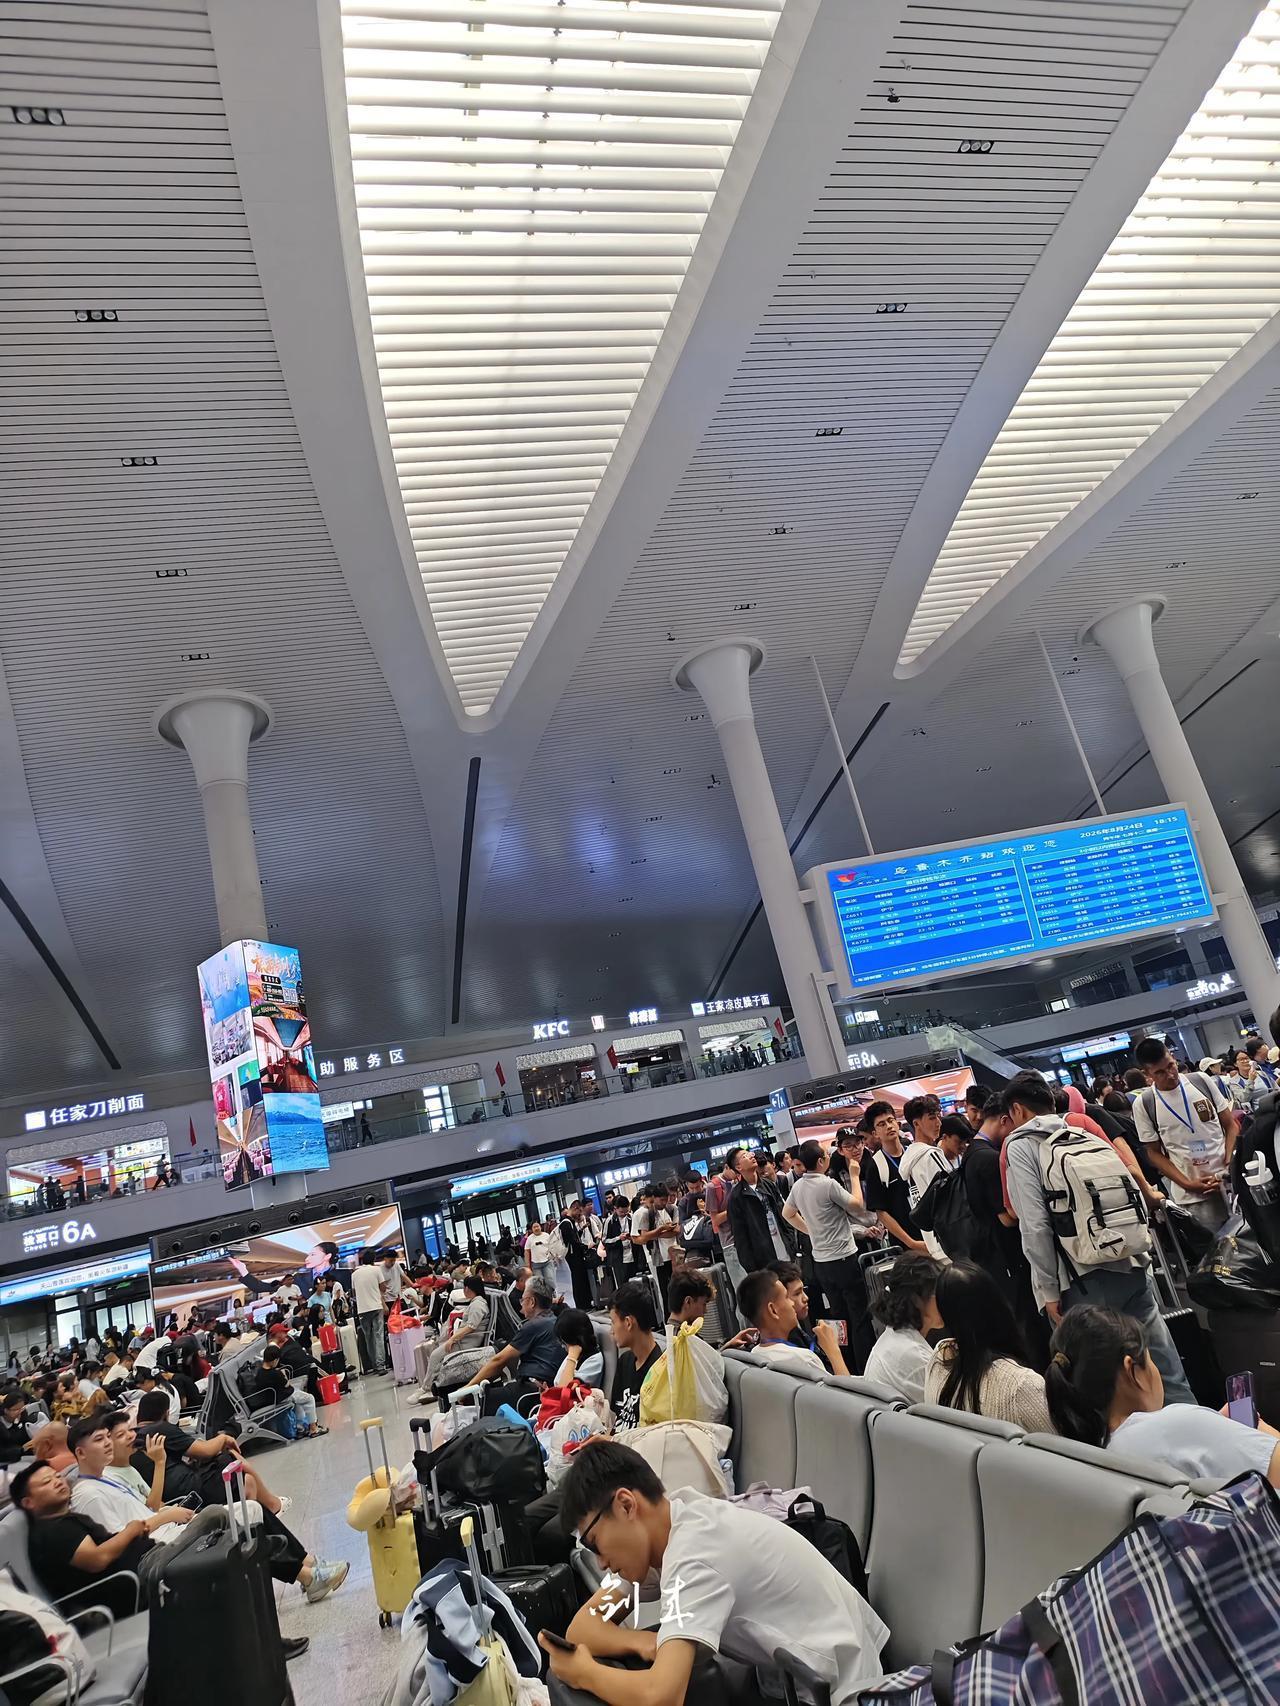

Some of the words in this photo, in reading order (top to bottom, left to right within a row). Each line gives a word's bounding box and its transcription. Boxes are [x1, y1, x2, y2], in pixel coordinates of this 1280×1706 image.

[1079, 822, 1143, 838] 2026年8月24日
[1154, 816, 1177, 824] 18:15
[893, 839, 1056, 875] 乌鲁木齐站欢迎您
[706, 993, 770, 1016] 王家凉皮臊子面
[533, 1021, 569, 1040] KFC
[319, 1048, 407, 1076] 助服务区
[861, 1050, 878, 1068] 8A
[50, 1093, 145, 1125] 任家刀削面
[23, 1231, 59, 1246] 检票口
[63, 1220, 97, 1243] 6A
